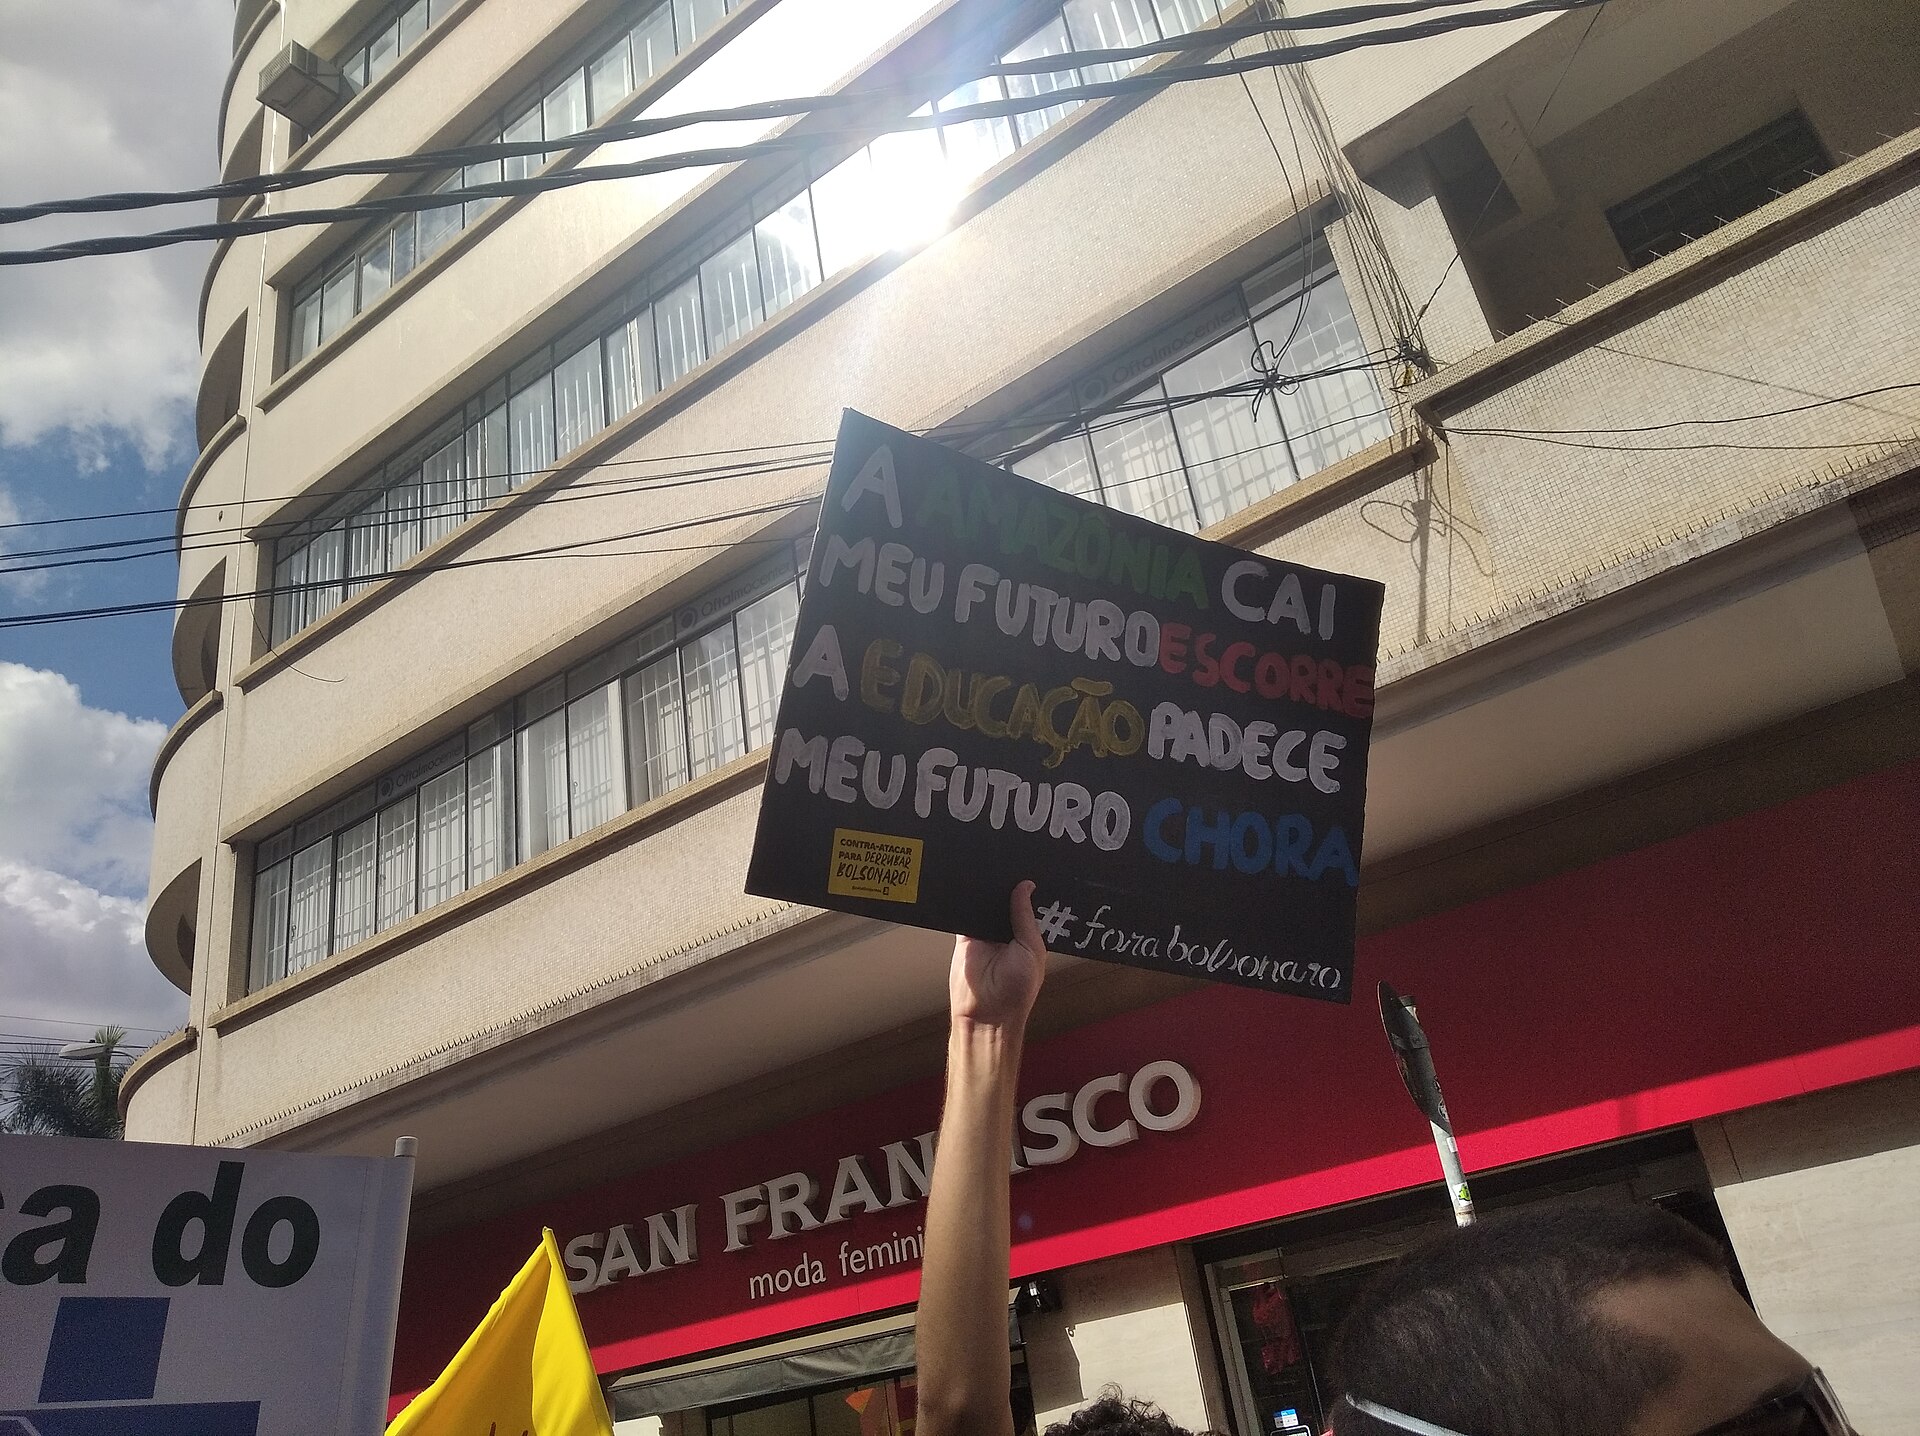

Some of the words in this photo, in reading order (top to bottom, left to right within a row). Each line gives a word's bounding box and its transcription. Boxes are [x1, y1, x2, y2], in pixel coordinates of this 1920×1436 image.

[1112, 306, 1237, 384] Oftalmocenter
[841, 445, 903, 528] A
[915, 467, 1210, 609] AMAZÔNIA
[1221, 560, 1337, 641] CAI
[819, 534, 945, 614] MEU
[954, 564, 1160, 668] FUTURO
[1159, 621, 1375, 718] ESCORRE
[792, 624, 850, 701] A
[859, 638, 1145, 768] EDUCAÇÃO
[1147, 701, 1348, 793] PADECE
[774, 727, 907, 810] MEU
[914, 746, 1131, 851] FUTURO
[1143, 799, 1360, 886] CHORA
[838, 850, 862, 862] PARA
[864, 851, 912, 869] DERRUBAR
[840, 838, 912, 856] CONTRA-ATACAR
[836, 862, 910, 887] BOLSONARO!
[0, 1184, 100, 1287] a
[152, 1160, 320, 1288] do
[564, 1203, 700, 1295] SAN
[718, 1060, 1203, 1253] FRANSCO
[748, 1251, 827, 1300] moda
[838, 1225, 924, 1277] femini
